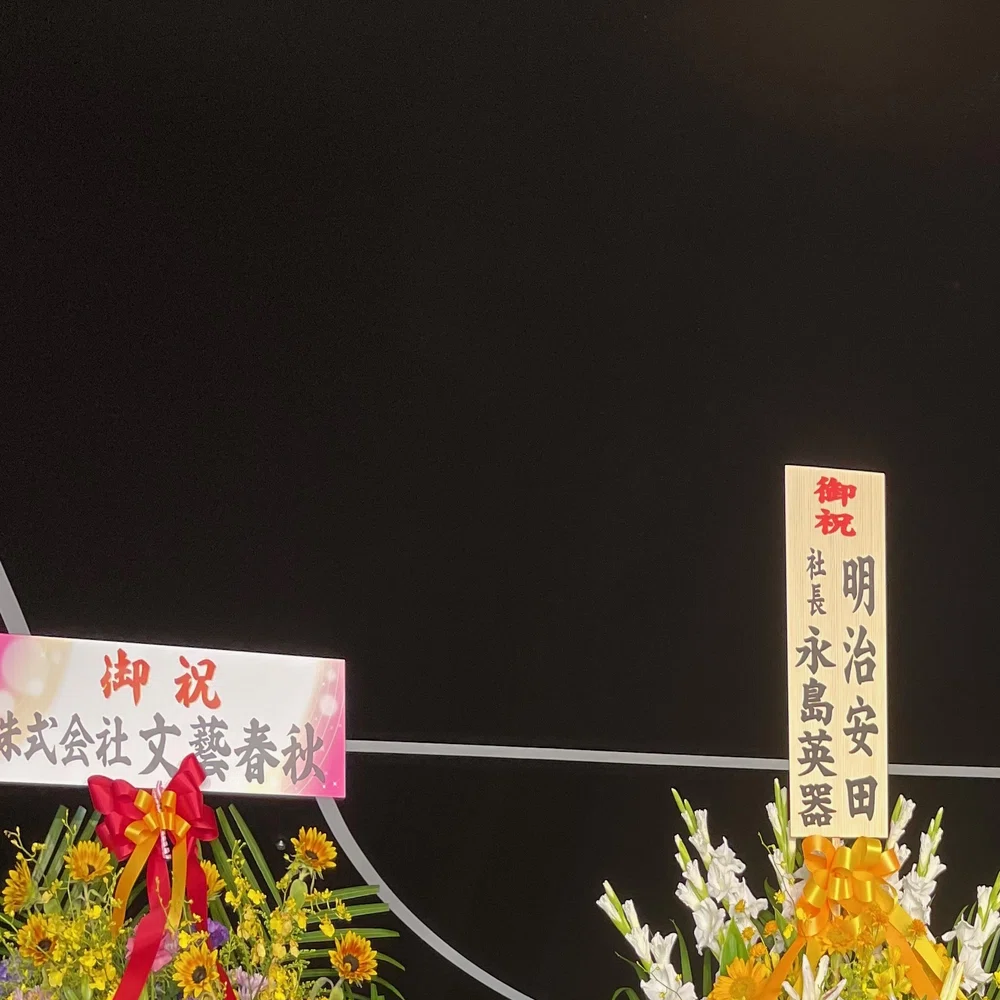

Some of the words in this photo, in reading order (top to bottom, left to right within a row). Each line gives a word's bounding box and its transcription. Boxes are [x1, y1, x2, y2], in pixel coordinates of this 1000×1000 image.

[814, 475, 858, 537] 御祝
[842, 555, 879, 822] 明治安田
